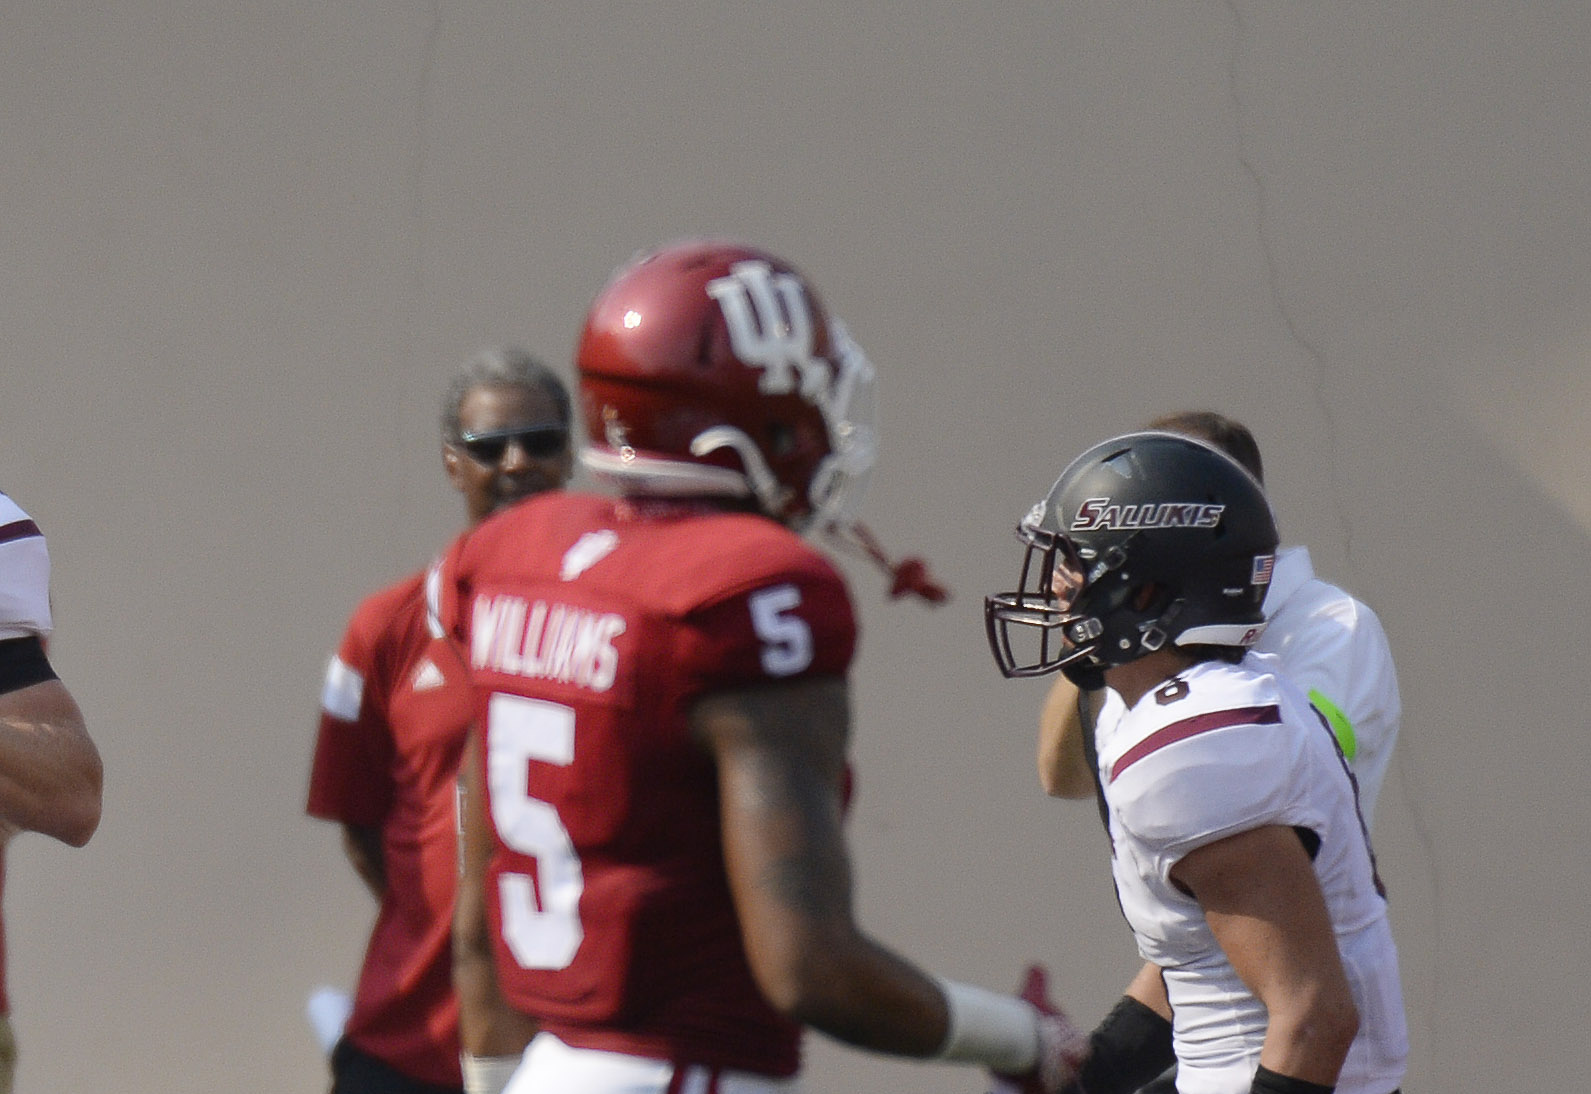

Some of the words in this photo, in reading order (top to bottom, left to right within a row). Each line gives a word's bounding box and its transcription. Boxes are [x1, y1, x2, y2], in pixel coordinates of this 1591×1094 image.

[1070, 497, 1226, 532] SALUKIS
[471, 593, 627, 693] WILLIAMS
[749, 583, 814, 677] 5
[487, 691, 585, 971] 5
